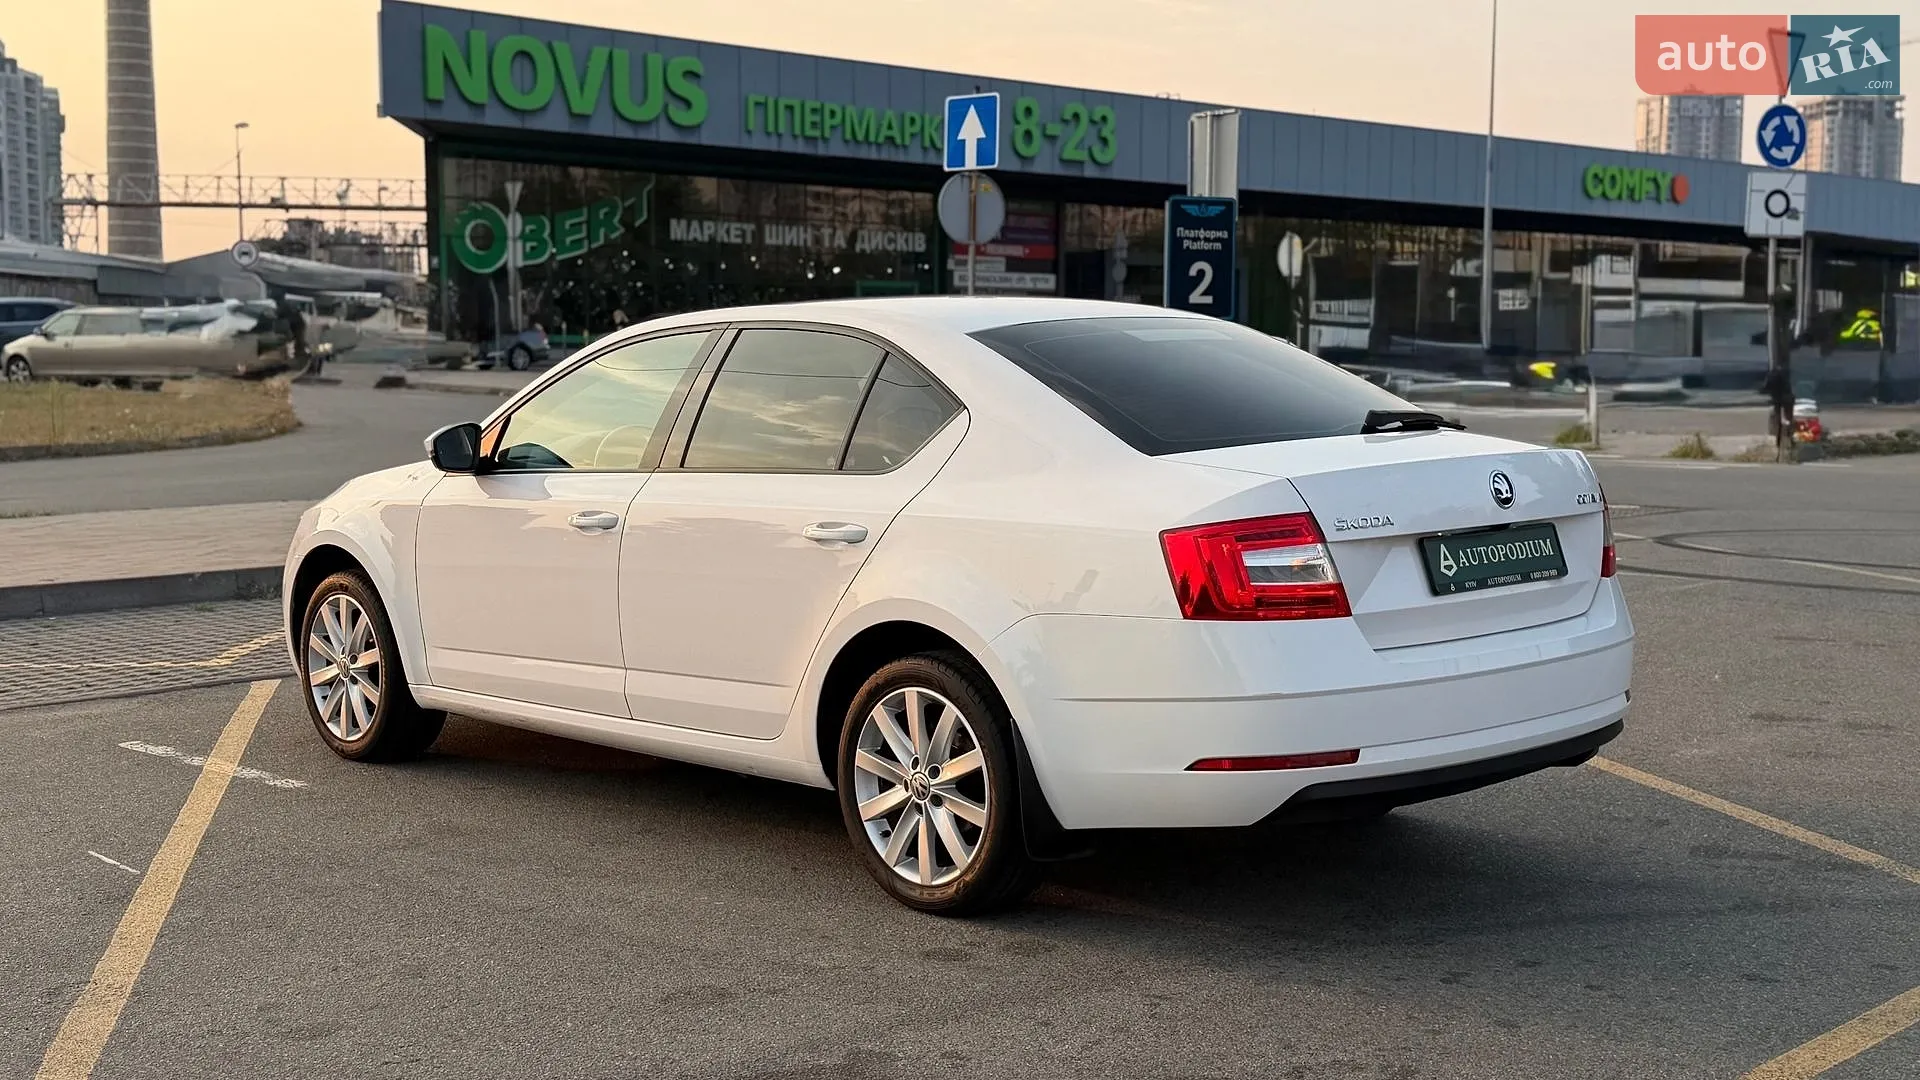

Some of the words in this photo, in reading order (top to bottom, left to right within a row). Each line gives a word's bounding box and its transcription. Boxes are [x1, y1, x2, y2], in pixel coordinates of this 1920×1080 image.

[424, 24, 709, 127] NOVUS
[745, 94, 943, 150] ГІПЕРМАРК
[1013, 96, 1118, 165] 8-23
[1584, 163, 1673, 204] COMFY
[669, 218, 756, 244] МАРКЕТ
[764, 223, 812, 248] ШИН
[820, 229, 847, 249] ТА
[855, 229, 927, 253] ДИСКІВ
[1176, 227, 1229, 240] Платформа
[1182, 239, 1222, 251] Platform
[1188, 261, 1214, 304] 2
[1459, 538, 1554, 568] AUTOPODIUM
